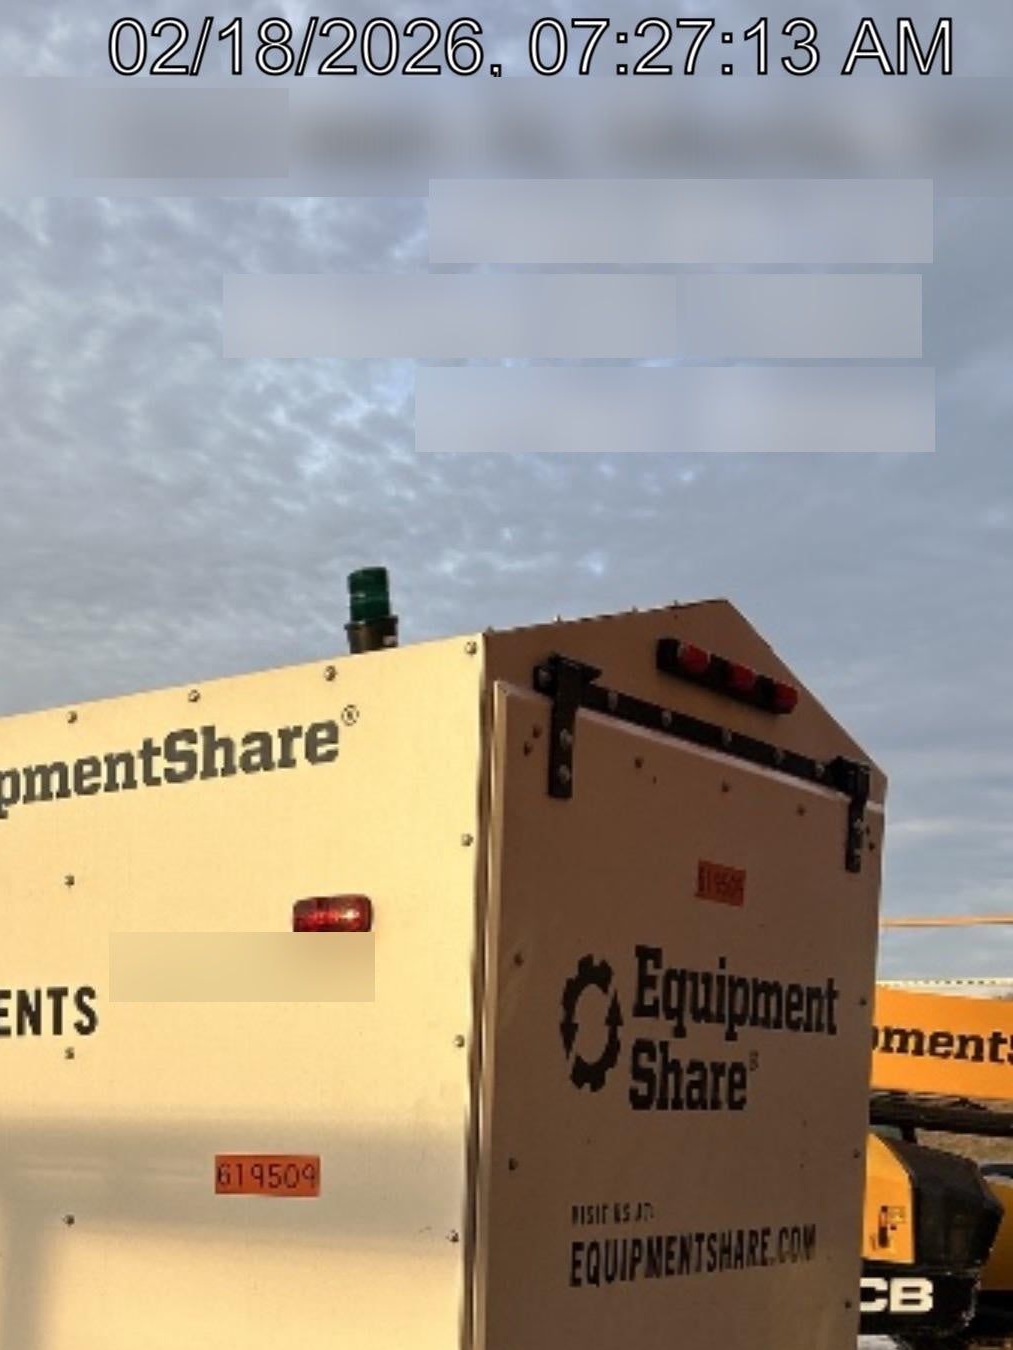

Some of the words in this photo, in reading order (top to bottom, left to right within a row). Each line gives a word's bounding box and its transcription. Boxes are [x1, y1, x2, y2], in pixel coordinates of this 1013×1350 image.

[632, 945, 840, 1042] Equipment
[217, 1163, 316, 1189] 619509
[569, 1224, 816, 1287] EQUIPMENTSHARE.COM
